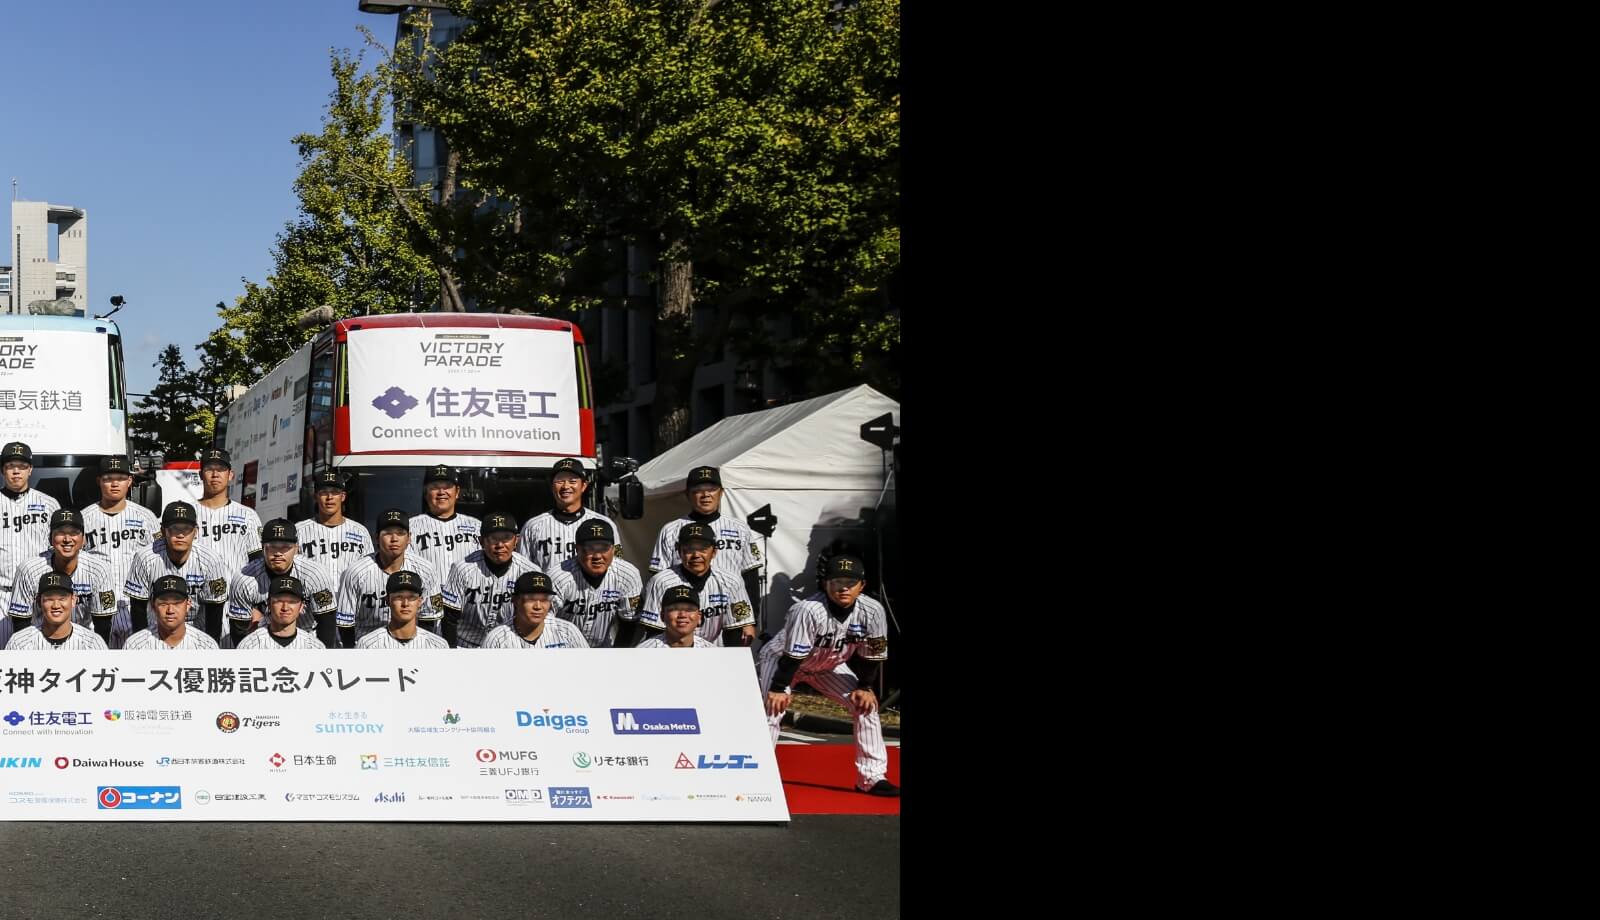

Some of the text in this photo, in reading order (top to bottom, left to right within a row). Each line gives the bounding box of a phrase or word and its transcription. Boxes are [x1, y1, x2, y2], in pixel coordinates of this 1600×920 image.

[419, 341, 504, 353] VICTORY
[424, 355, 502, 367] PARADE
[427, 387, 560, 419] 住友電工
[372, 425, 561, 440] Connect with Innovation
[202, 521, 247, 541] igers
[85, 528, 146, 550] Tigers
[302, 539, 364, 559] Tigers
[538, 537, 577, 559] Tig
[29, 711, 93, 726] 住友電工
[124, 710, 192, 720] 阪神電気鉄道
[328, 711, 368, 720] 水と生きる
[516, 711, 588, 729] Daigas
[242, 717, 281, 729] Tigers
[643, 723, 697, 731] Osaka Metro
[566, 727, 590, 735] Group
[294, 755, 336, 766] 日本生命
[499, 751, 538, 760] MUFG
[595, 756, 649, 766] りそな銀行
[73, 758, 144, 767] Daiwa House
[697, 754, 759, 769] レンゴー
[479, 768, 539, 776] 三菱UFJ銀行
[122, 792, 179, 803] コーナン
[374, 792, 405, 803] Asahi
[552, 795, 590, 805] オフテクス
